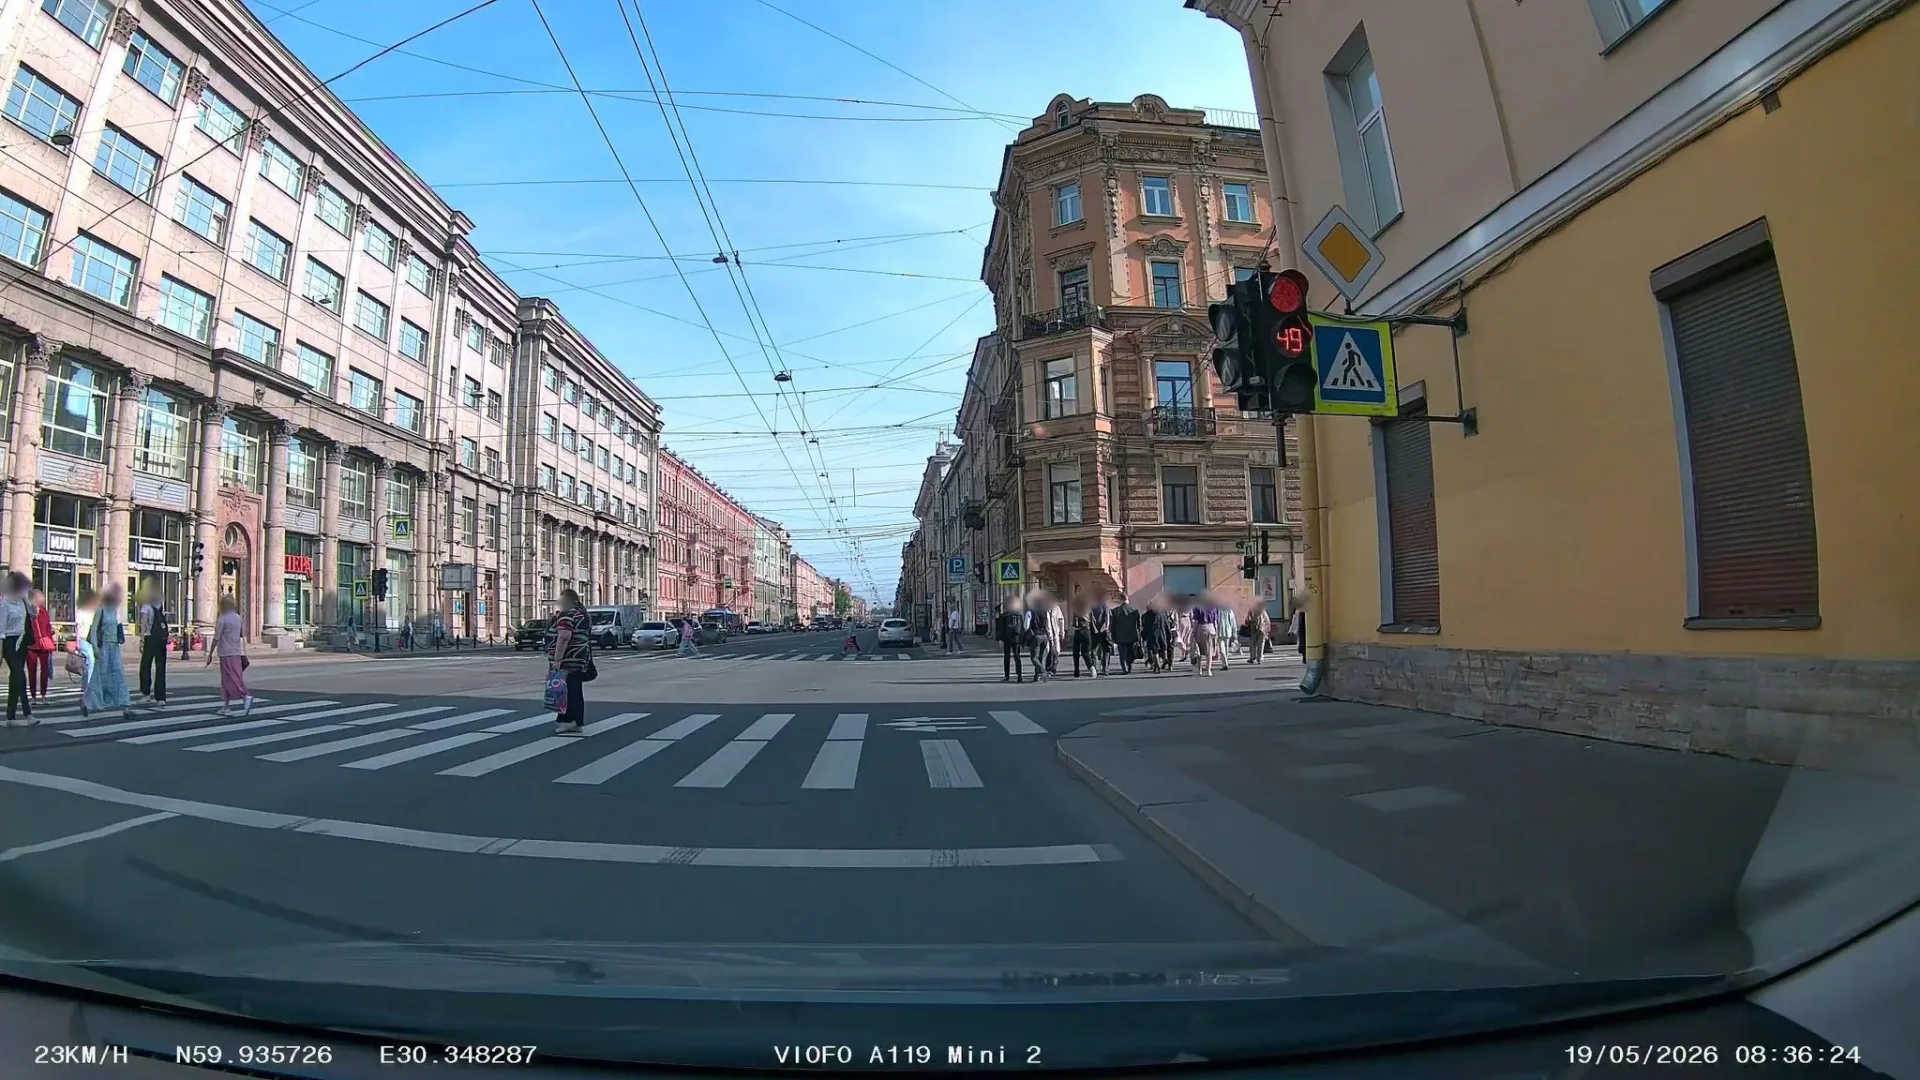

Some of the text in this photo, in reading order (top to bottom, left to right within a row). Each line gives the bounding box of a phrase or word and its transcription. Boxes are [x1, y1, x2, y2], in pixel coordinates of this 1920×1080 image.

[1276, 327, 1303, 352] 49
[50, 535, 75, 551] ИЛИ
[142, 546, 163, 560] ИЛИ
[953, 559, 963, 572] P
